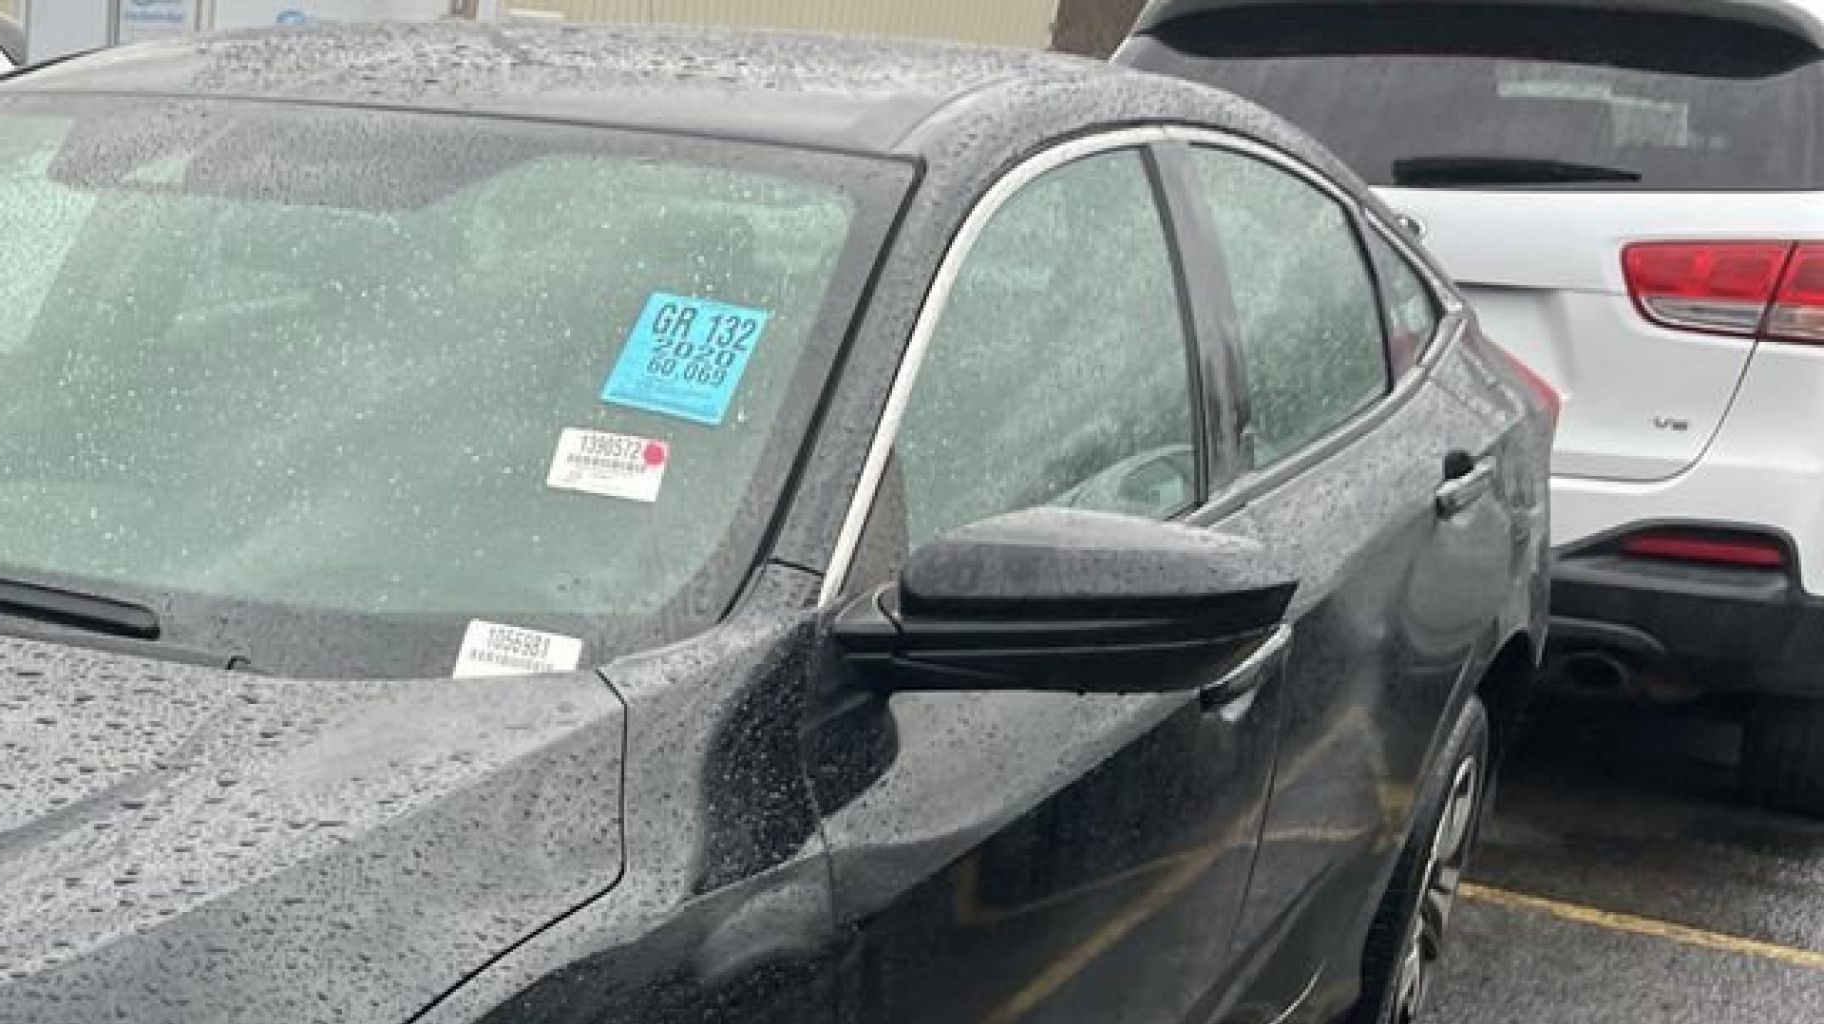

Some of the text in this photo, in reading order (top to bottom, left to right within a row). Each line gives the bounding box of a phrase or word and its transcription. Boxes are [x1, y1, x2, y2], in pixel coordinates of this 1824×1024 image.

[652, 303, 757, 352] GR 132
[652, 337, 737, 368] 2020
